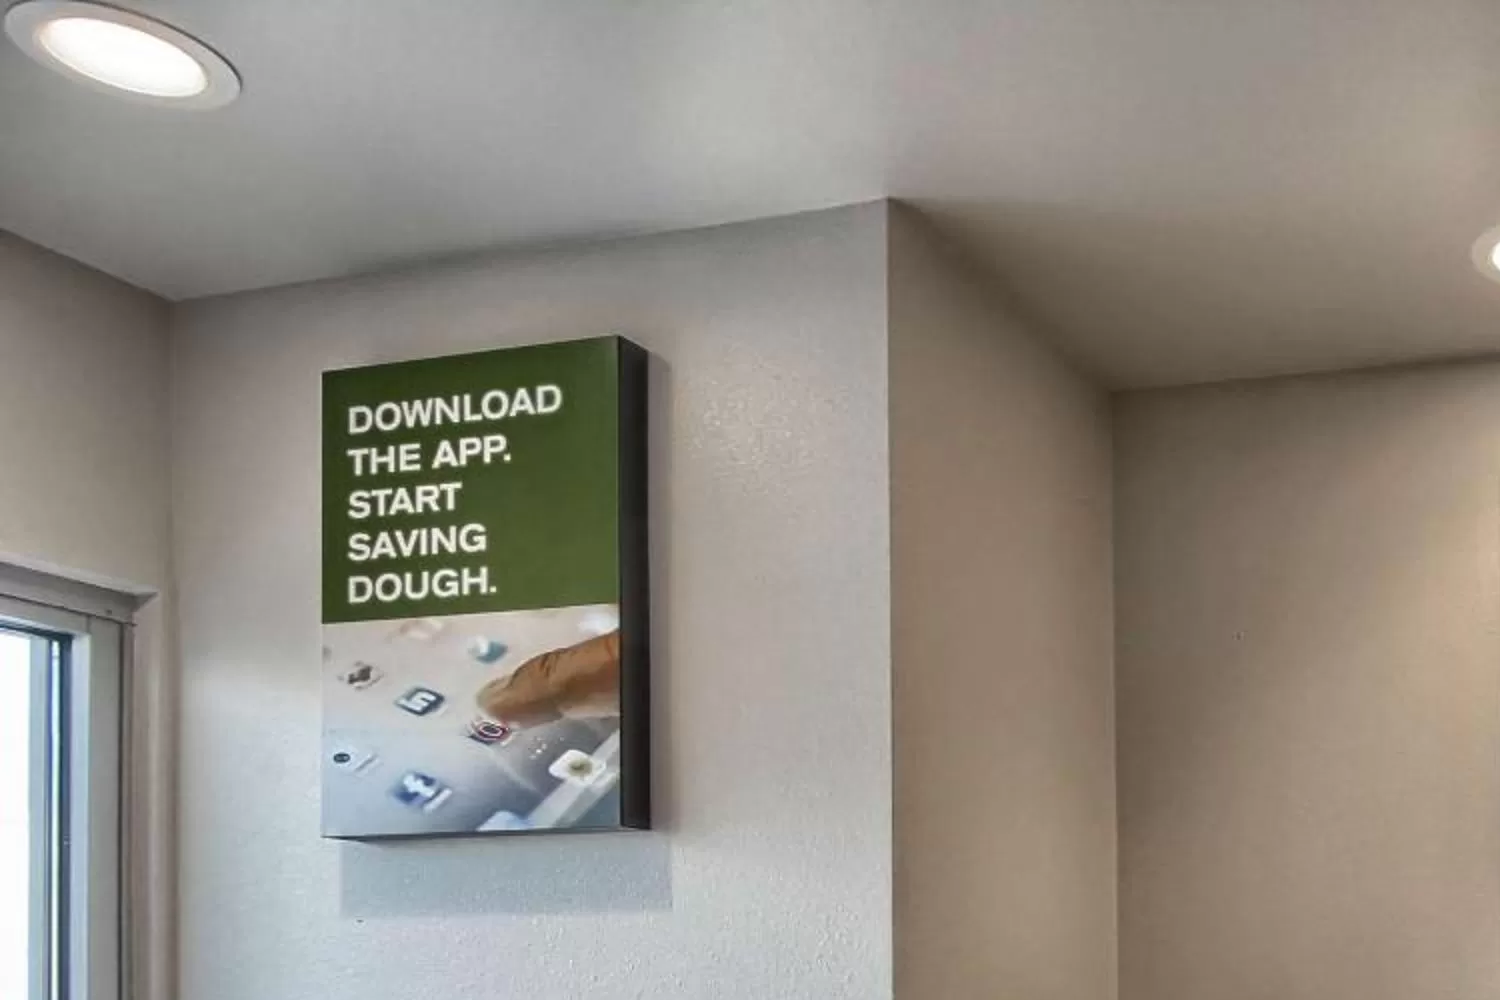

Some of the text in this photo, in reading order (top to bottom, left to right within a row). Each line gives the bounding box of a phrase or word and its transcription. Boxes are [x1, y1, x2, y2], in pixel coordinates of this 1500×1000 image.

[348, 384, 562, 435] DOWNLOAD
[347, 434, 511, 476] THE APP.
[348, 482, 463, 519] START
[348, 523, 487, 561] SAVING
[348, 566, 498, 604] DOUGH.
